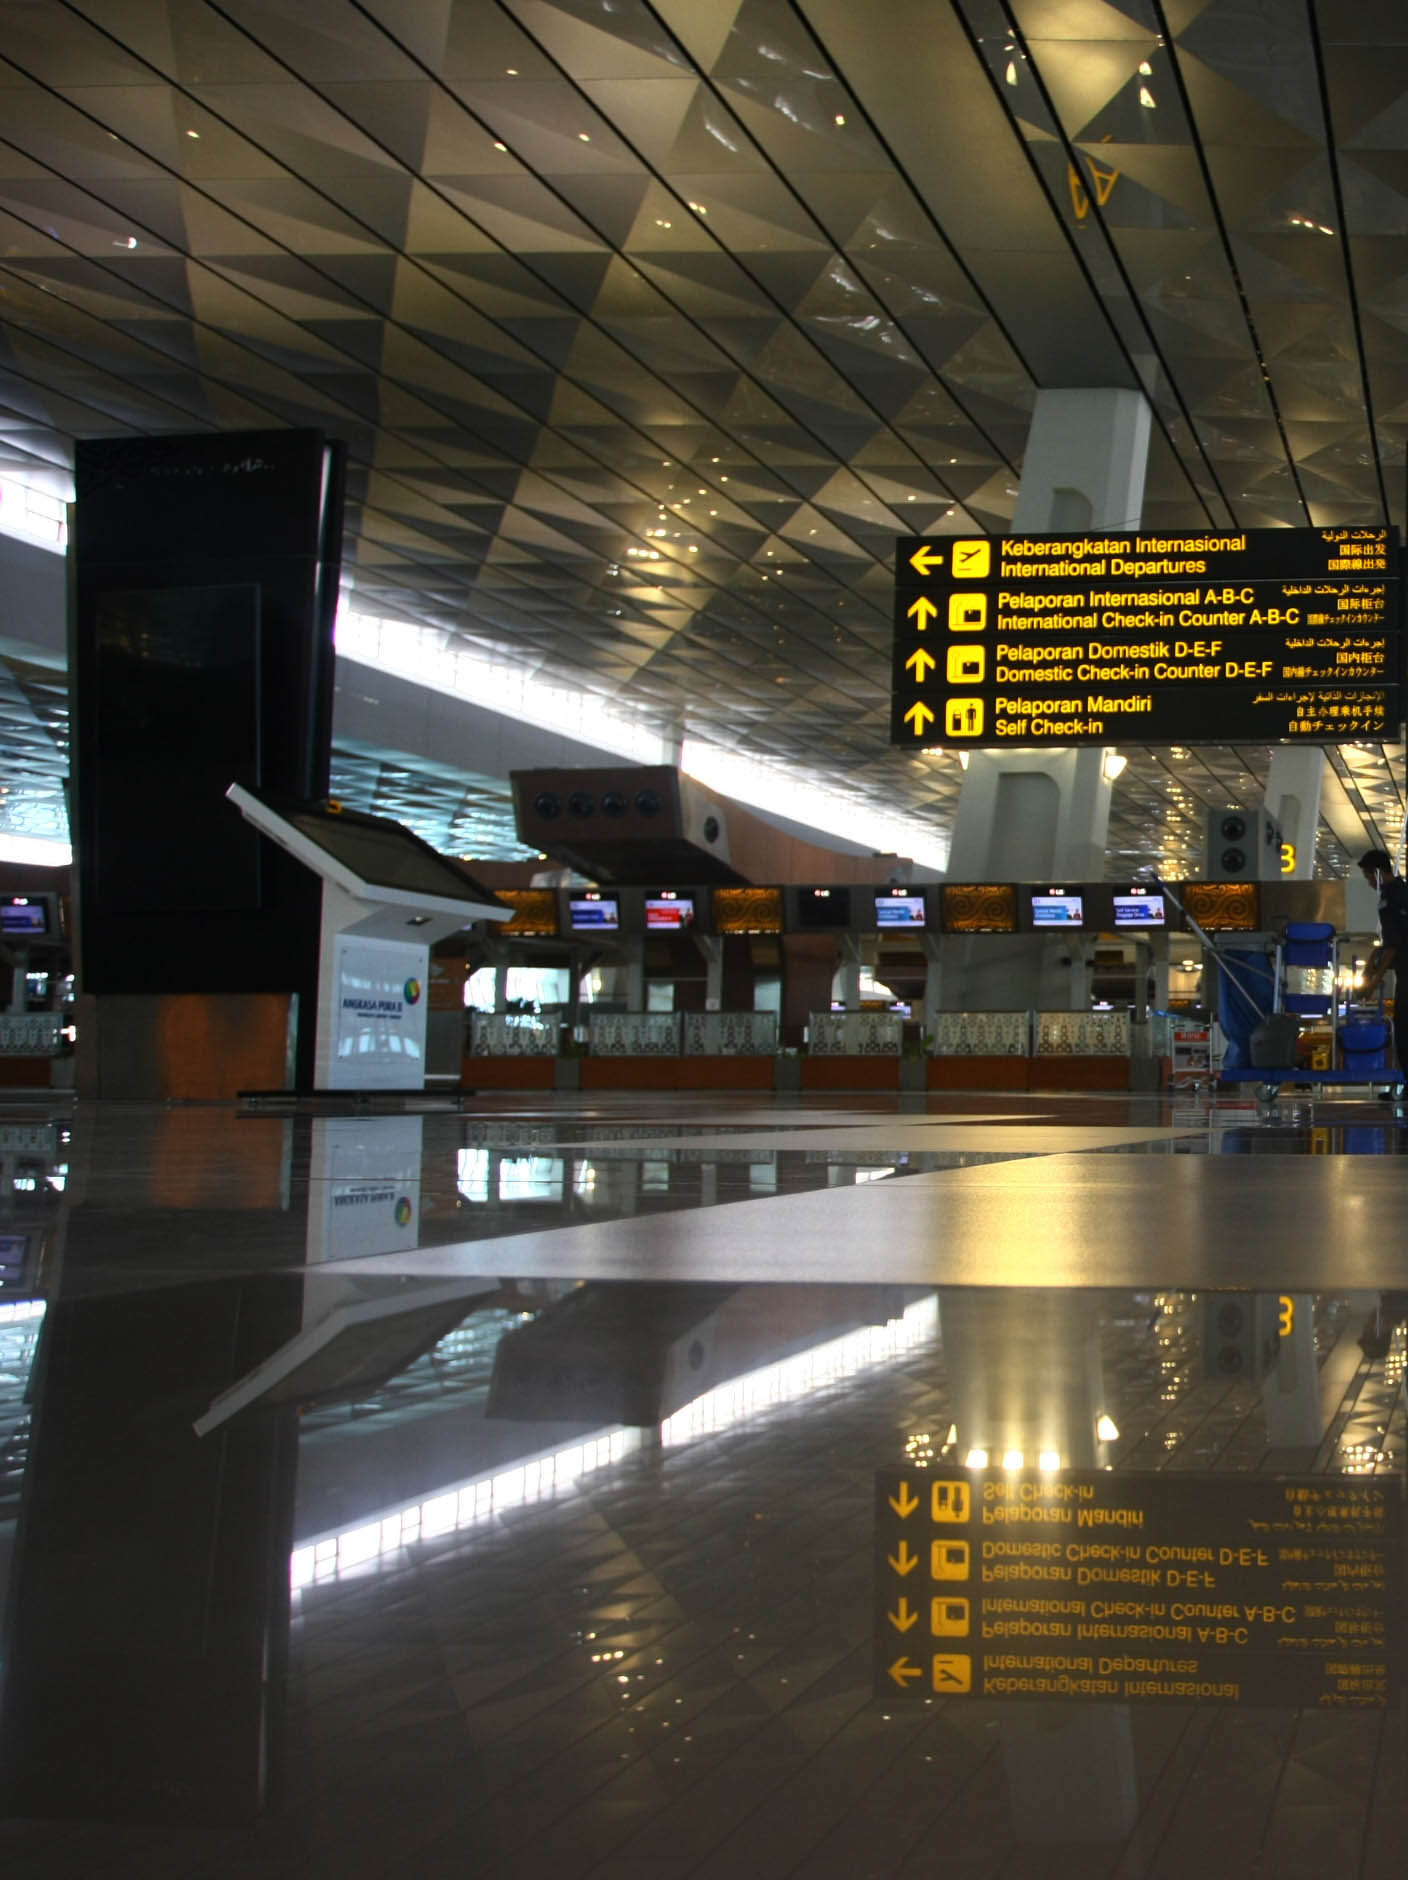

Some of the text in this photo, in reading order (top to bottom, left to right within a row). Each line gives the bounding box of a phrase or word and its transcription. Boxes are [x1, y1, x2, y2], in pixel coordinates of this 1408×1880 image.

[1002, 535, 1245, 558] Keberangkatan Internasional
[1001, 559, 1206, 578] International Departures
[998, 588, 1254, 612] Pelaporan Internasional A-B-C
[998, 608, 1299, 630] International Check-in Counter A-B-C
[997, 641, 1222, 664] Pelaporan Domestik D-E-F
[996, 662, 1272, 682] Domestic Check-in Counter D-E-F
[996, 696, 1152, 717] Pelaporan Mandiri
[996, 718, 1103, 736] Self Check-in
